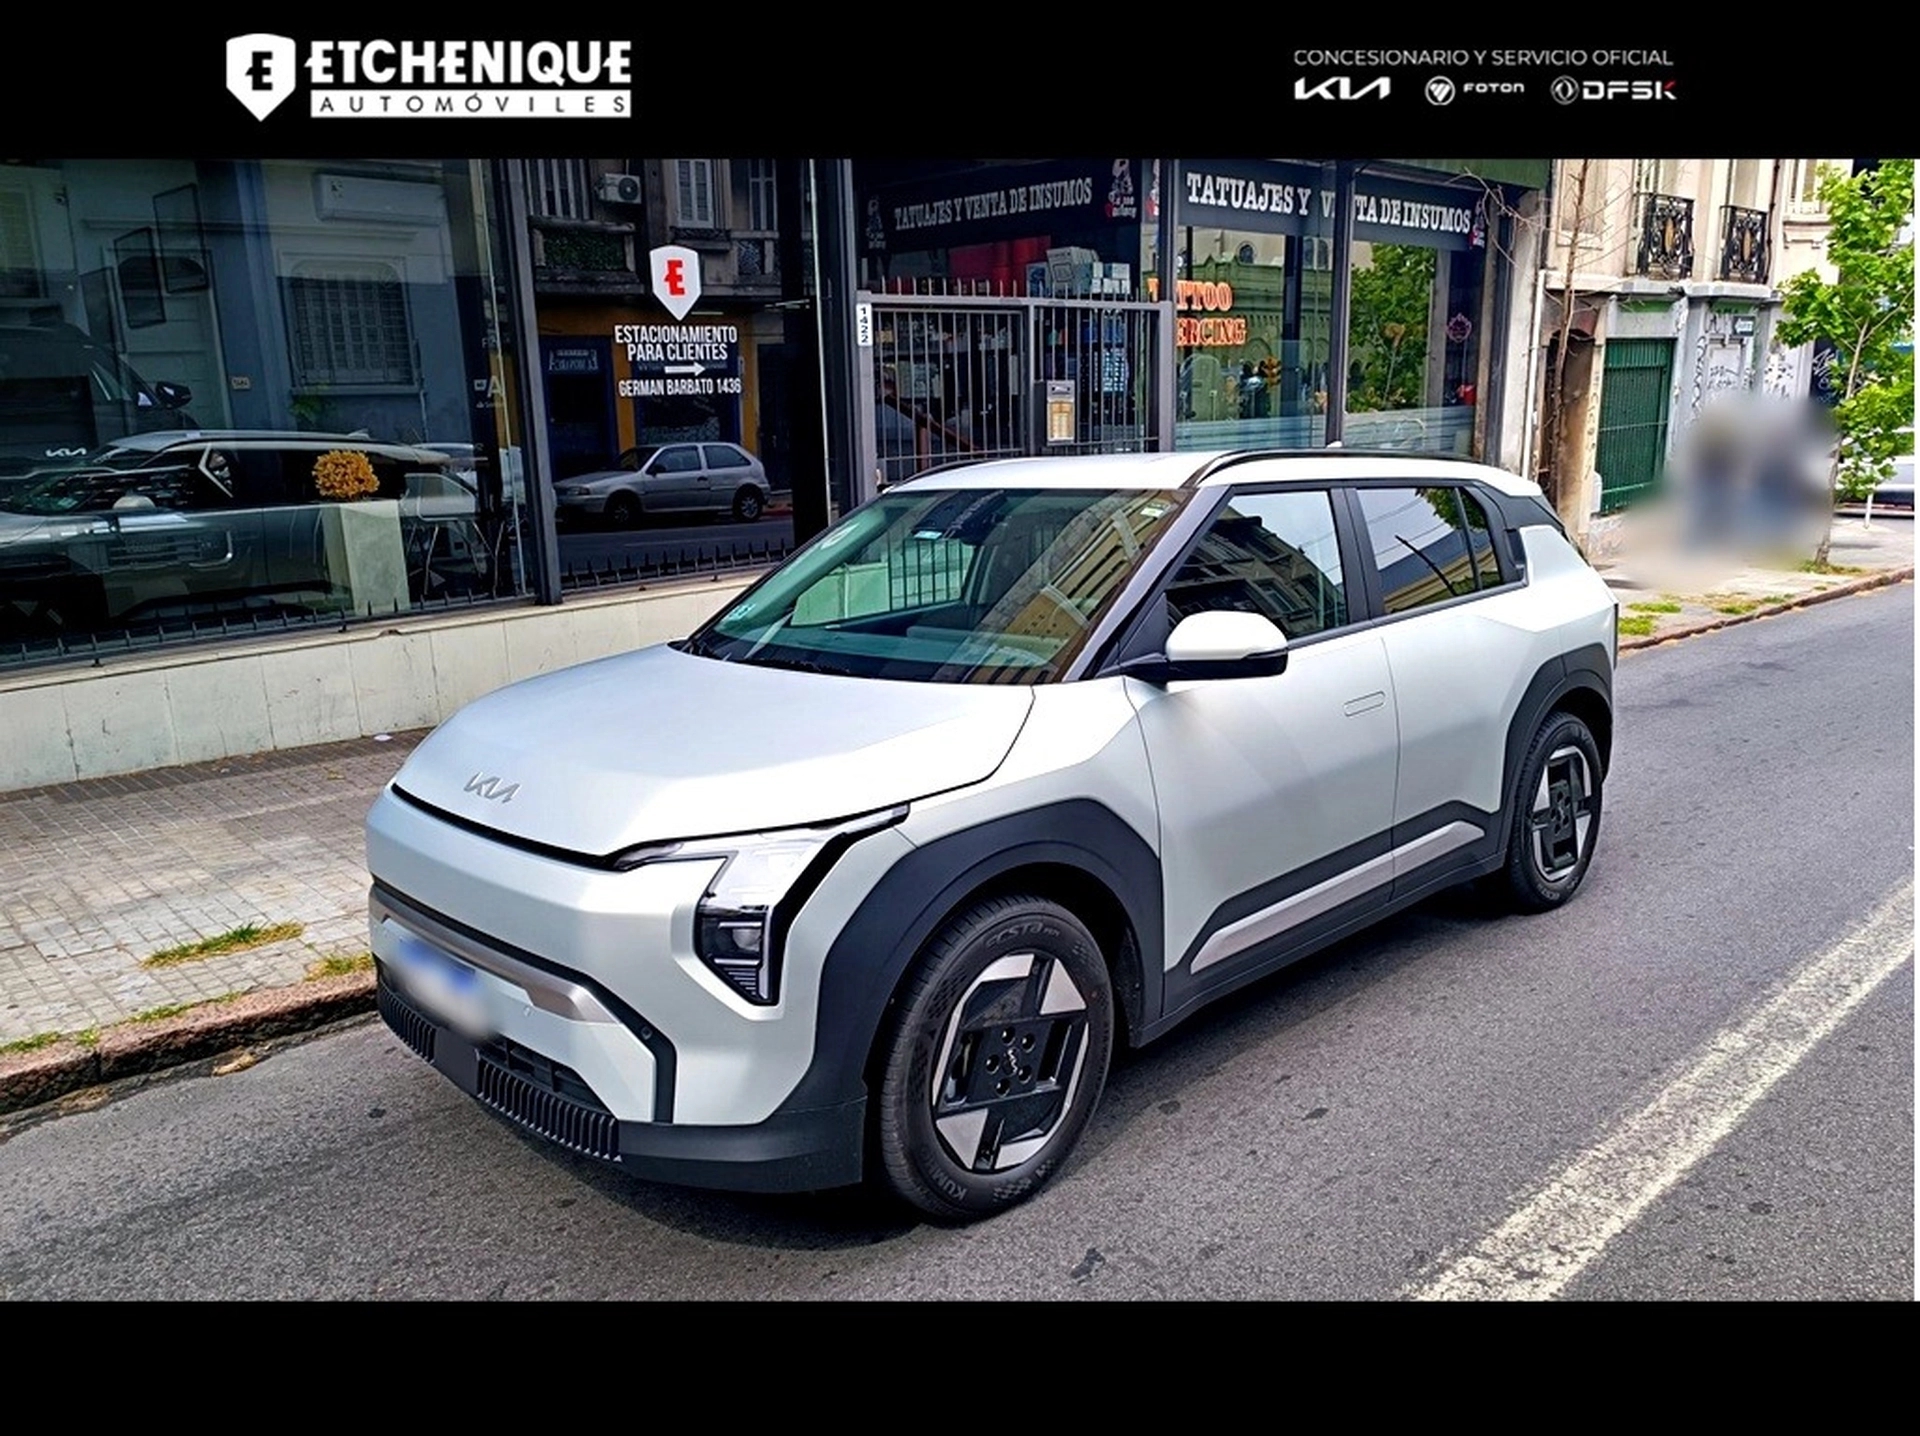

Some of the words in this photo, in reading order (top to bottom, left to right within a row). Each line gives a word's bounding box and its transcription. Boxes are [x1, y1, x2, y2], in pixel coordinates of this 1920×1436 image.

[894, 199, 953, 231] TATUAJES
[954, 198, 963, 222] Y
[964, 190, 1008, 220] VENTA
[1009, 186, 1027, 214] DE
[1029, 177, 1093, 211] INSUMOS
[1187, 172, 1294, 214] TATUAJES
[1297, 187, 1311, 215] Y
[1379, 198, 1401, 225] DE
[1402, 201, 1471, 234] INSUMOS
[614, 325, 738, 343] ESTACIONAMIENTO
[627, 344, 664, 361] PARA
[666, 343, 728, 360] CLIENTES
[618, 379, 664, 396] GERMAN
[666, 379, 713, 395] BARBATO
[716, 378, 742, 394] 1436
